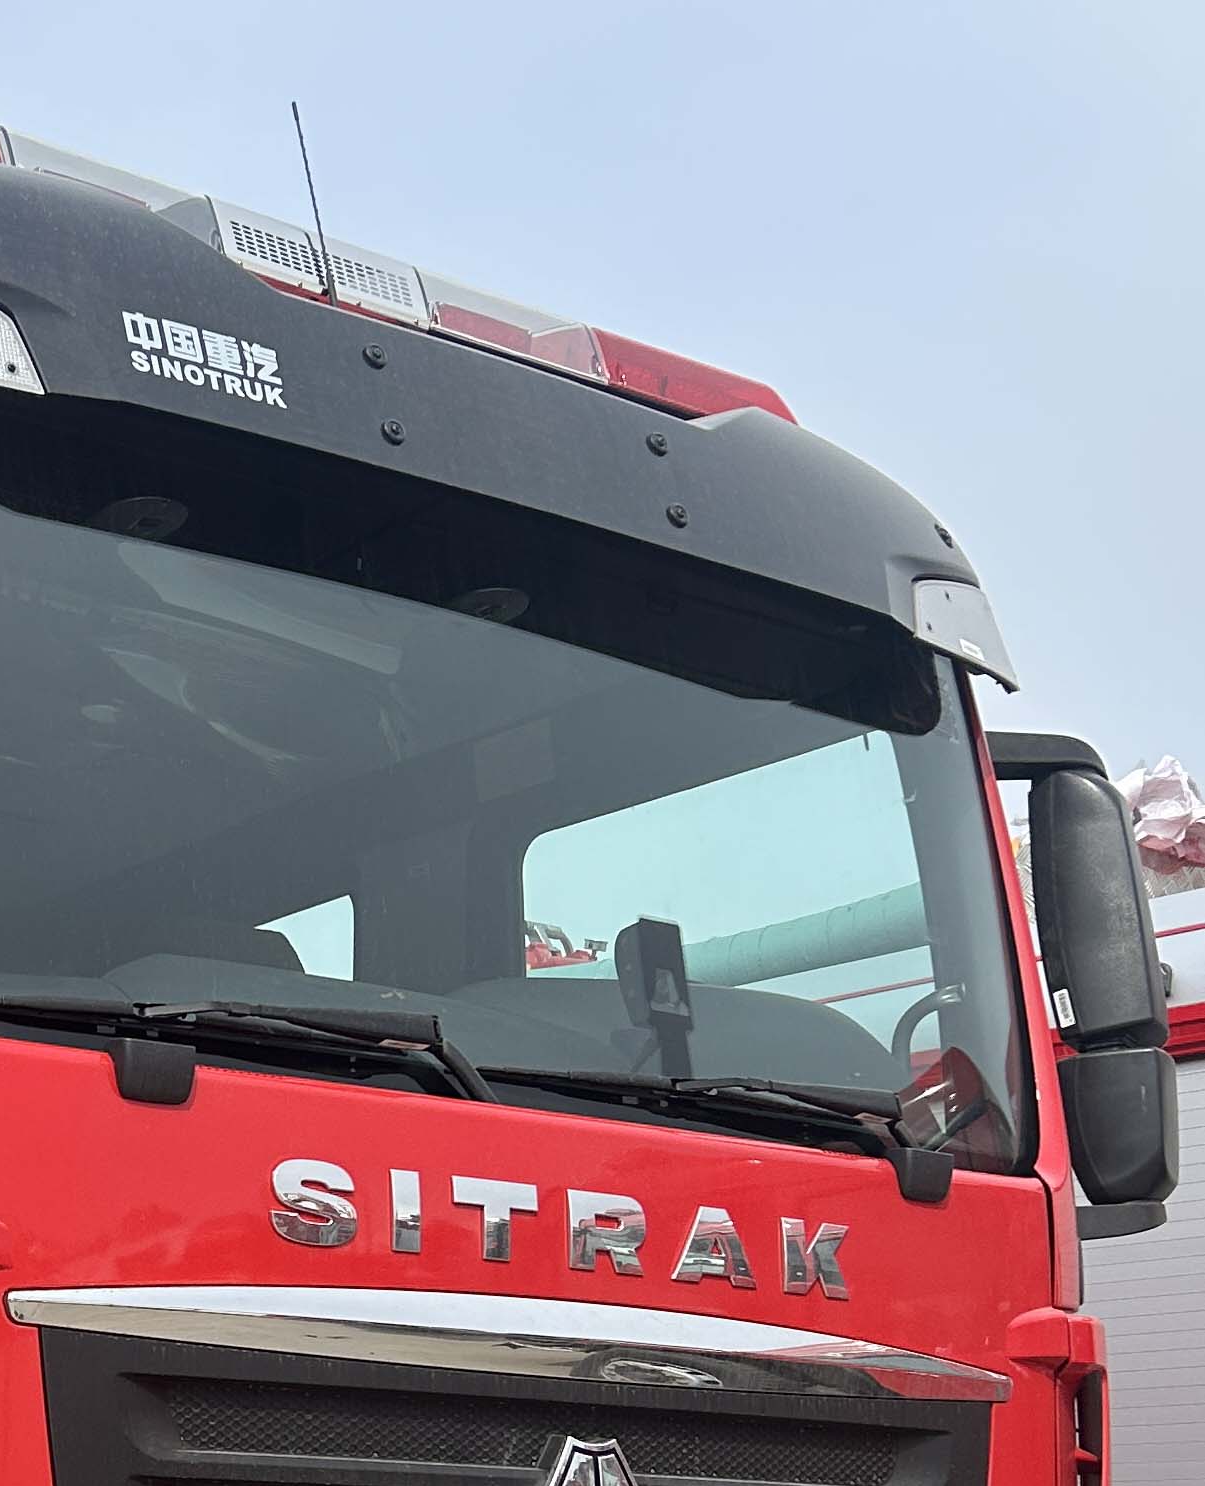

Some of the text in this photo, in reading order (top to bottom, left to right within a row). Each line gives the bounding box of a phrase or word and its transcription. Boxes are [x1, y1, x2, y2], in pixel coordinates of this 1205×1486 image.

[121, 310, 284, 386] 中国重汽
[130, 350, 288, 409] SINOTRUK
[270, 1158, 850, 1301] SITRAK
